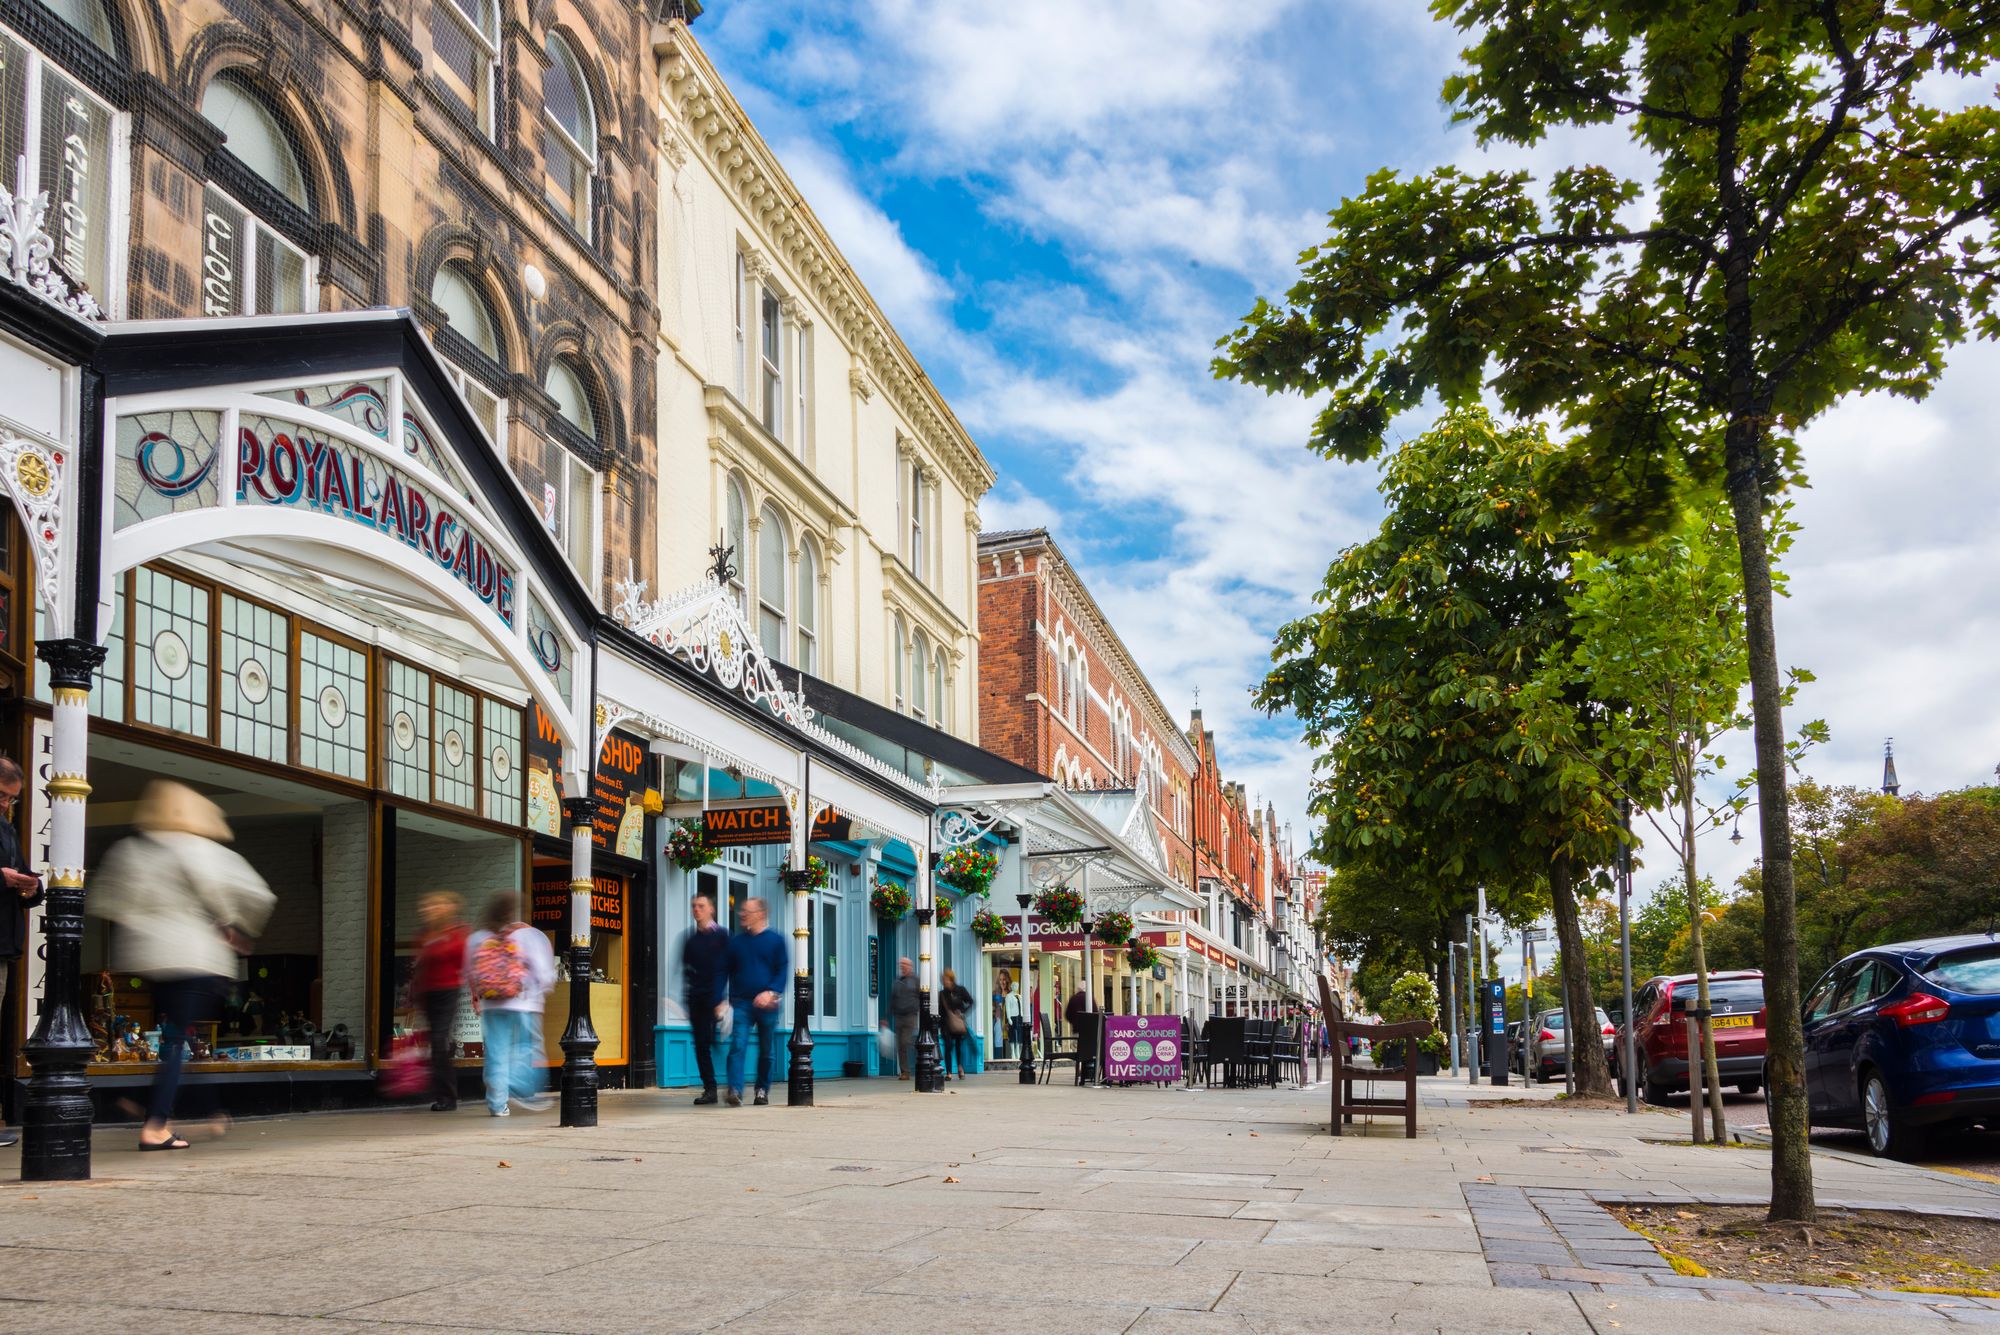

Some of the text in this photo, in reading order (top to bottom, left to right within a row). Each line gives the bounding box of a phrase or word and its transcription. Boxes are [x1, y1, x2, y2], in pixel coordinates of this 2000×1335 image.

[62, 97, 89, 277] & ANTIQUES
[236, 427, 513, 630] ROYAL ARCADE
[602, 735, 643, 776] SHOP
[530, 780, 540, 795] £5
[706, 808, 779, 830] WATCH
[532, 881, 569, 892] ATTERIES
[591, 876, 620, 896] ANTED
[535, 896, 567, 906] STRAPS
[590, 895, 620, 915] ATCHES
[533, 910, 562, 921] FITTED
[609, 920, 622, 930] OLD
[1494, 985, 1502, 996] P
[1733, 1017, 1749, 1026] LTK
[1113, 1029, 1177, 1038] SANDGROUNDER
